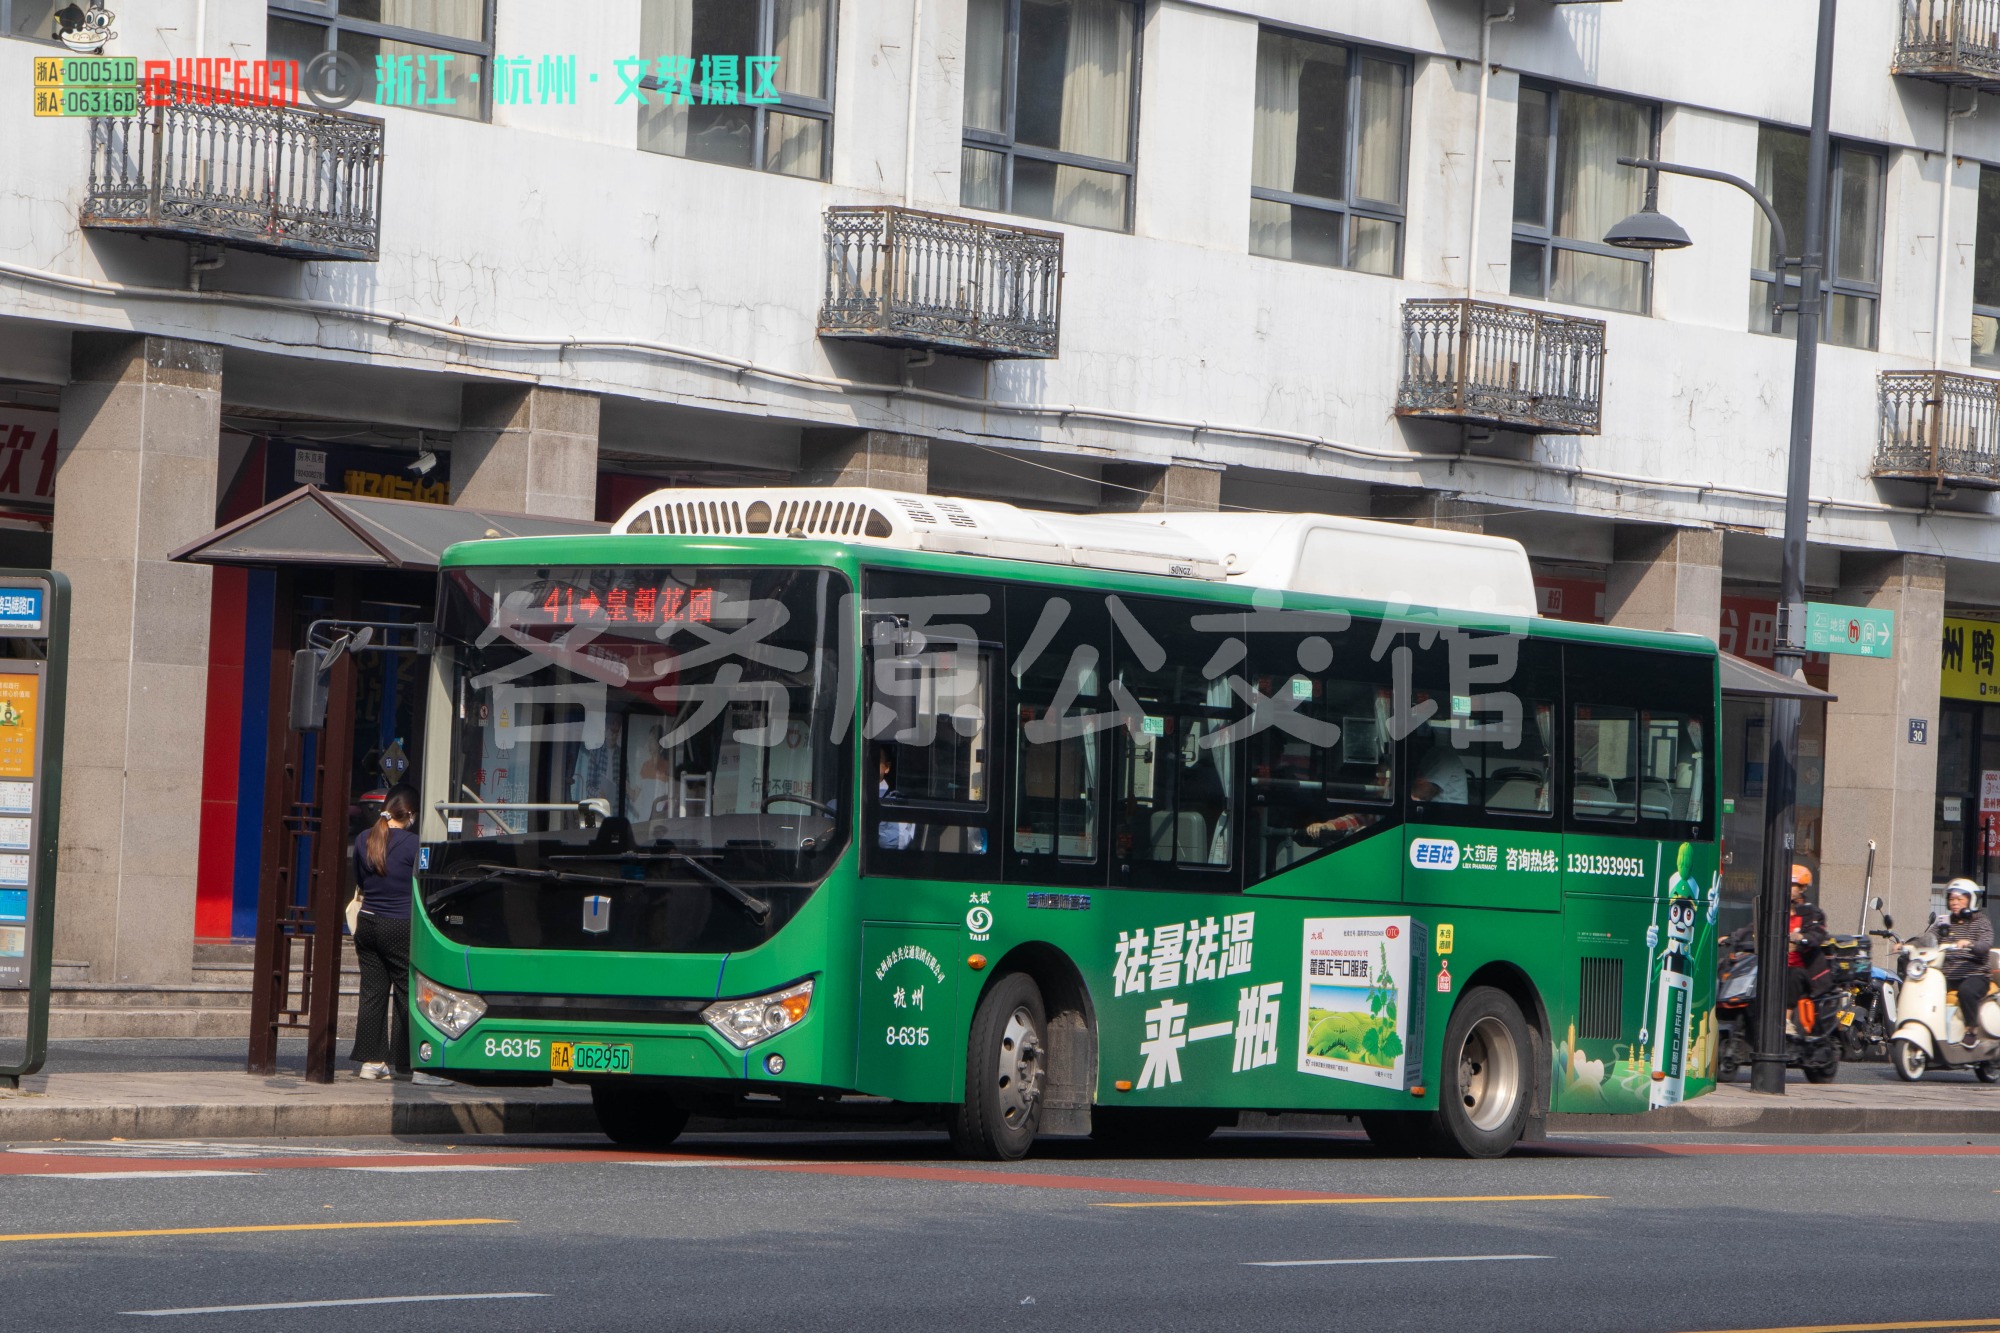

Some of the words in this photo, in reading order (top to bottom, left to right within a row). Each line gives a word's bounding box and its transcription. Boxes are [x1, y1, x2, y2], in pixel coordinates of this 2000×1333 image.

[543, 587, 574, 622] 41
[604, 587, 713, 622] 皇朝花园
[1829, 634, 1846, 643] Metro
[1912, 730, 1923, 742] 30
[1416, 844, 1454, 864] 老百姓
[1462, 844, 1498, 863] 大药房
[1567, 853, 1645, 878] 13913939951
[1386, 927, 1399, 938] OTC
[1112, 911, 1255, 998] 祛暑祛湿
[1310, 959, 1369, 978] 藿香正气口服液
[893, 985, 924, 1012] 杭州
[886, 1026, 930, 1046] 8-6315
[1136, 981, 1283, 1090] 来一瓶
[484, 1038, 541, 1058] 8-6315
